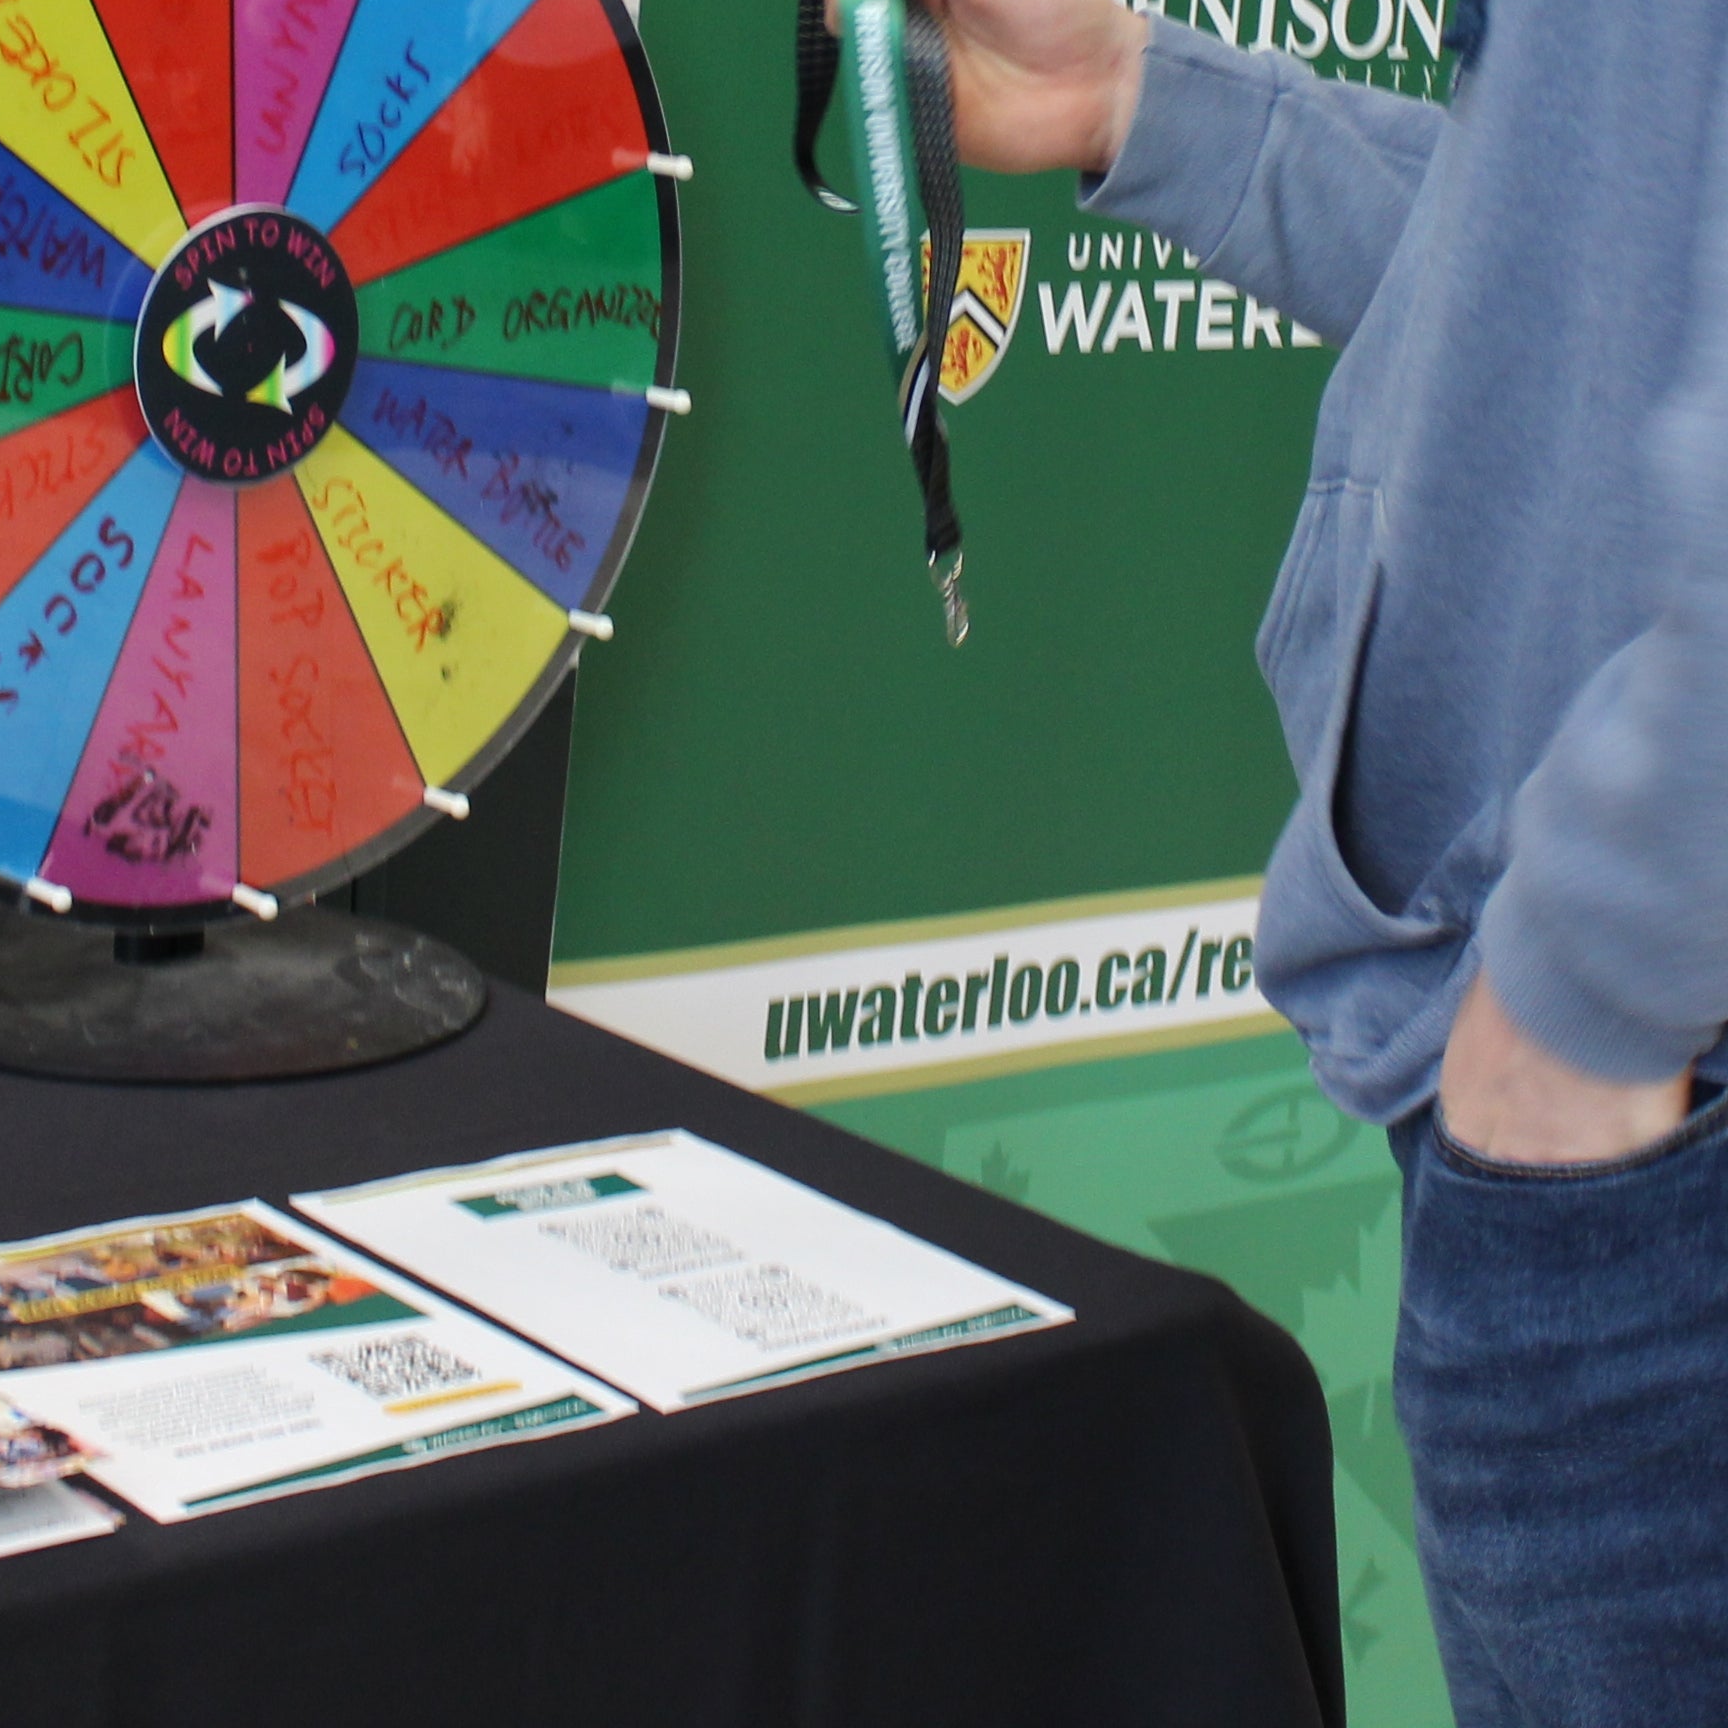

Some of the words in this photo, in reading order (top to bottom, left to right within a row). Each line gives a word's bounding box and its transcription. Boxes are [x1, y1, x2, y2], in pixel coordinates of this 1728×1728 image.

[175, 226, 236, 290] SPIN
[243, 218, 280, 248] TO
[287, 226, 336, 289] WIN
[163, 408, 216, 469] WIN
[223, 447, 259, 477] TO
[267, 403, 325, 469] SPIN
[255, 529, 324, 628] POP
[762, 926, 1256, 1062] uwaterloo.ca/re
